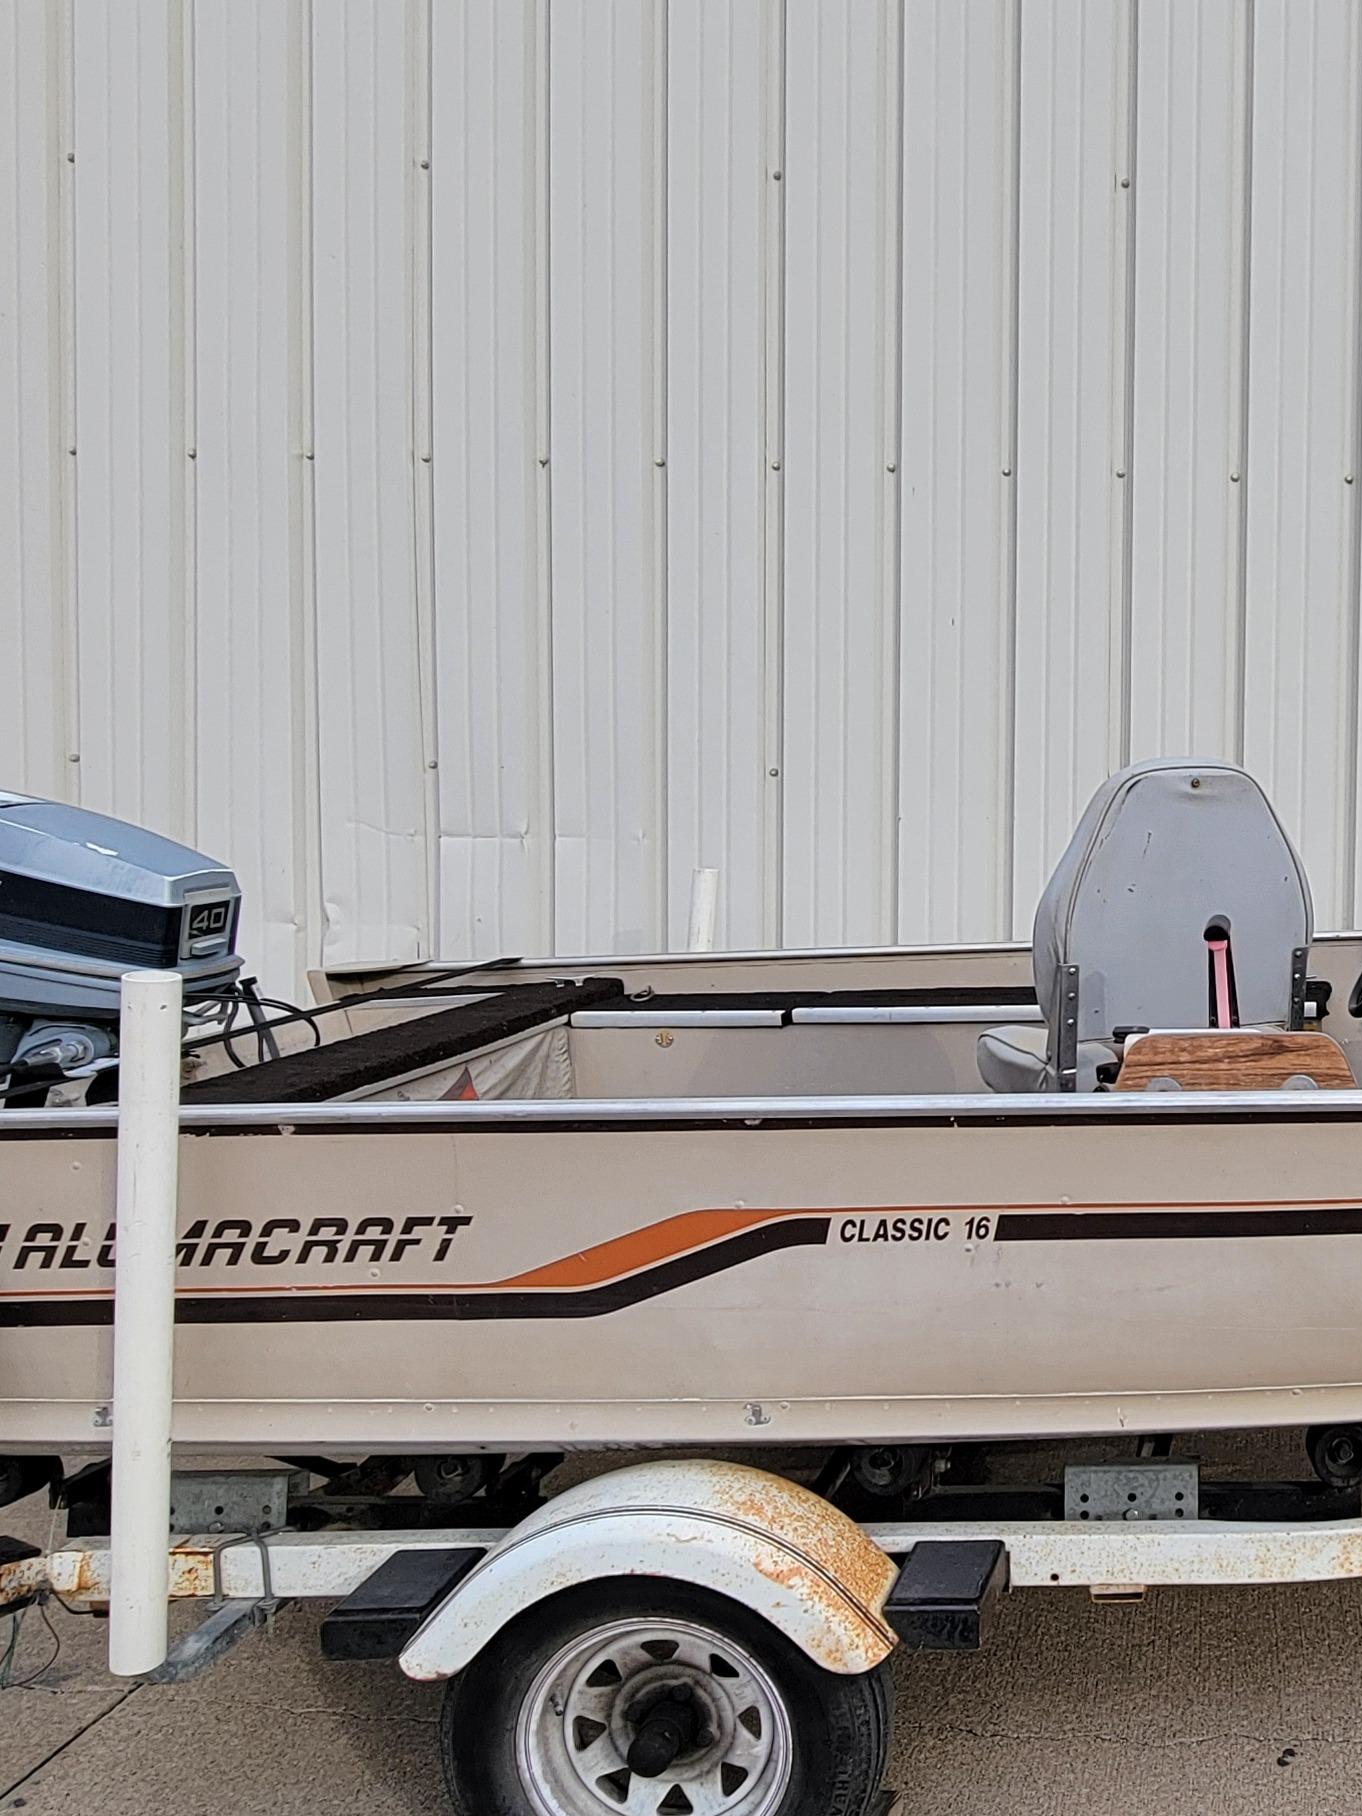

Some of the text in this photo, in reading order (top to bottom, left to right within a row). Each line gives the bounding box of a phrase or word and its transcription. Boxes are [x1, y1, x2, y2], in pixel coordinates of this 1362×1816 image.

[192, 907, 225, 930] 40
[840, 1216, 991, 1243] CLASSIC 16
